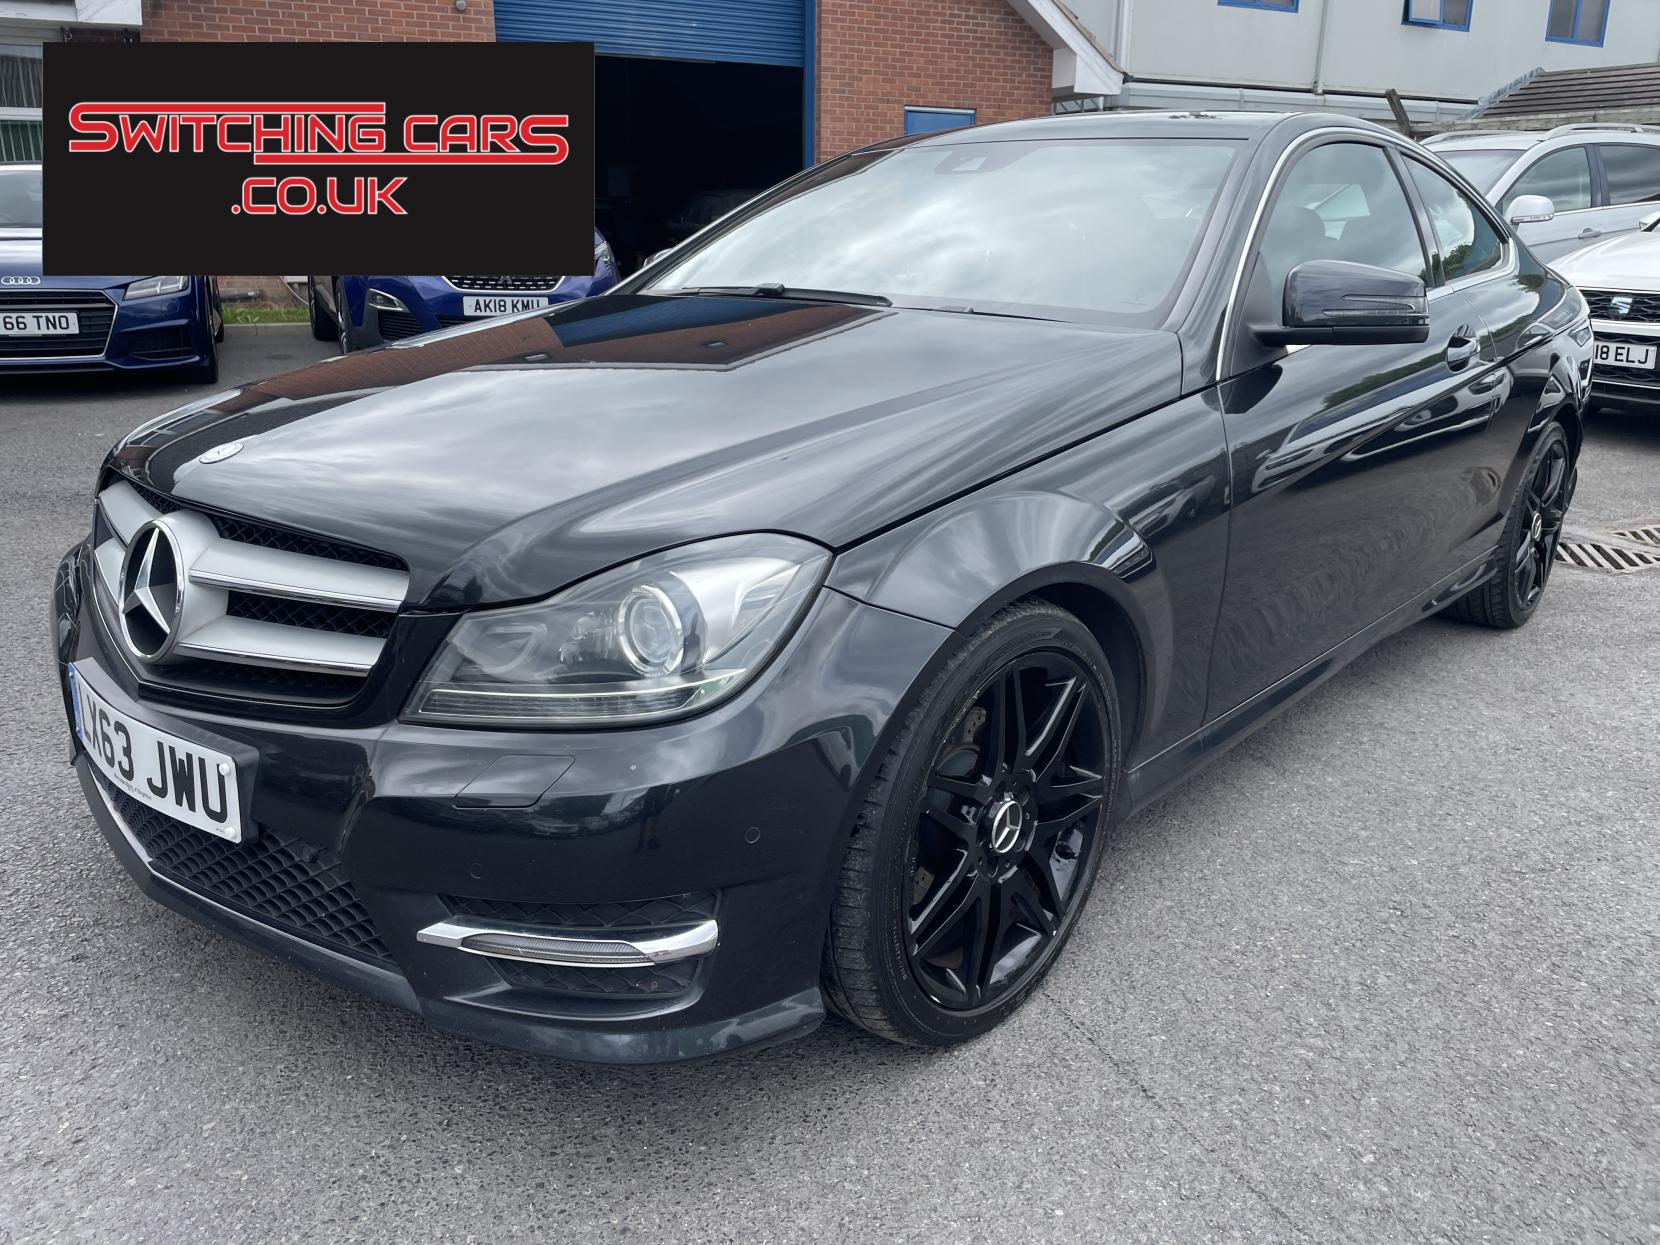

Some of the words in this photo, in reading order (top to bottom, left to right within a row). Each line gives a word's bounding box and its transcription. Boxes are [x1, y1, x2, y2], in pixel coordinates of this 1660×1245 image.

[474, 298, 507, 313] AK18
[2, 315, 28, 331] 66
[32, 315, 70, 331] TNO
[1614, 346, 1650, 365] ELJ
[78, 682, 135, 782] LX63
[146, 740, 228, 824] JWU
